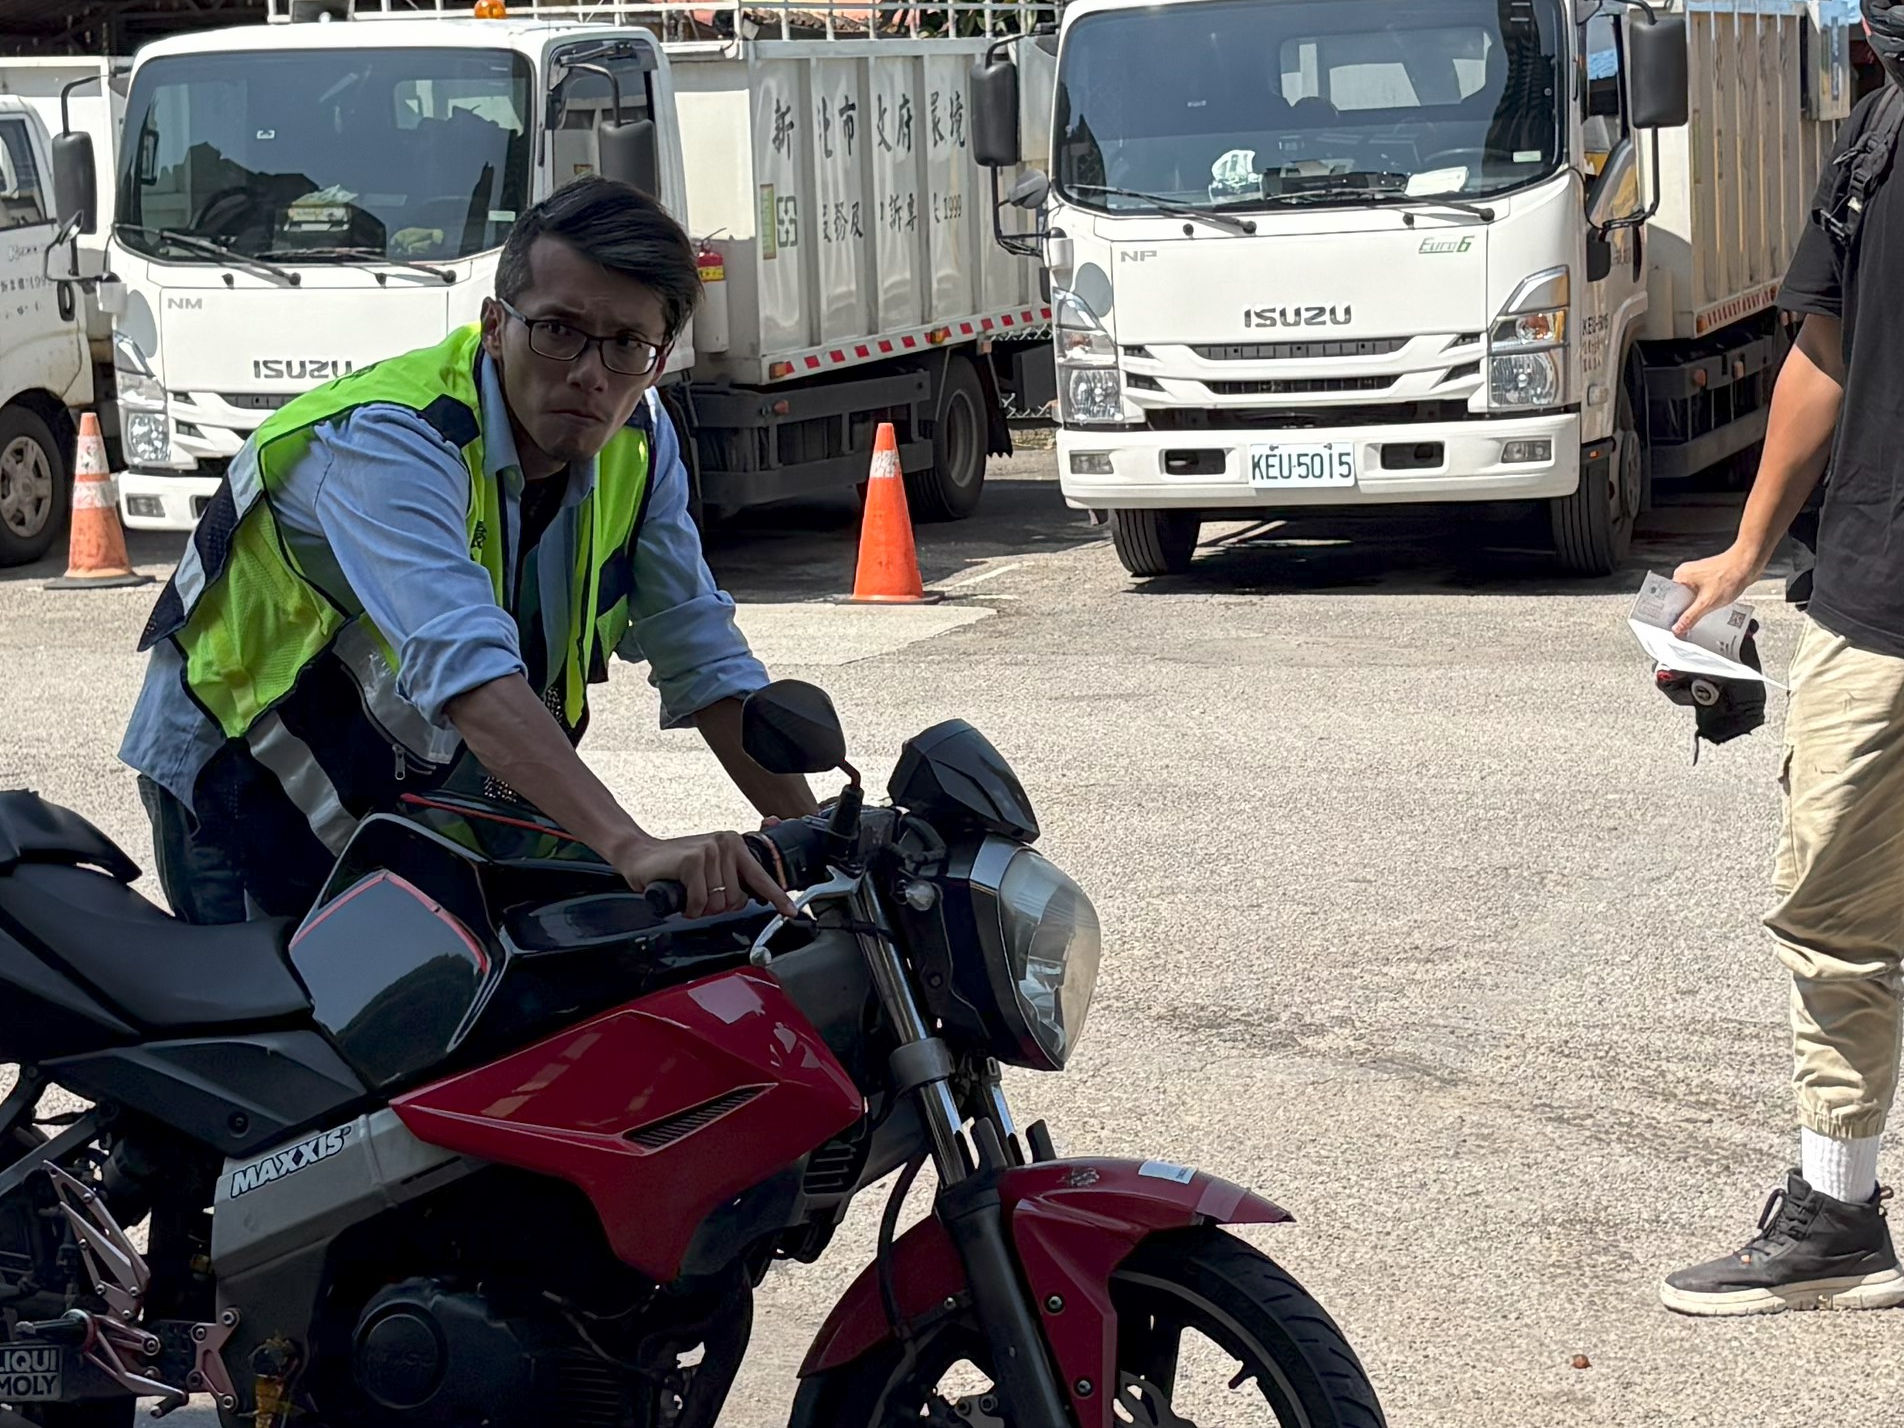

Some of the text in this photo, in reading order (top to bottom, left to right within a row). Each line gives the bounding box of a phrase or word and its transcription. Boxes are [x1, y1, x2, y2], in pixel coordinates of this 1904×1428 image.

[1120, 249, 1157, 263] NP
[167, 297, 203, 310] NM
[1243, 304, 1353, 328] ISUZU
[252, 359, 353, 379] ISUZU
[1251, 452, 1352, 481] KEU-5015
[230, 1128, 346, 1199] MAXXIS
